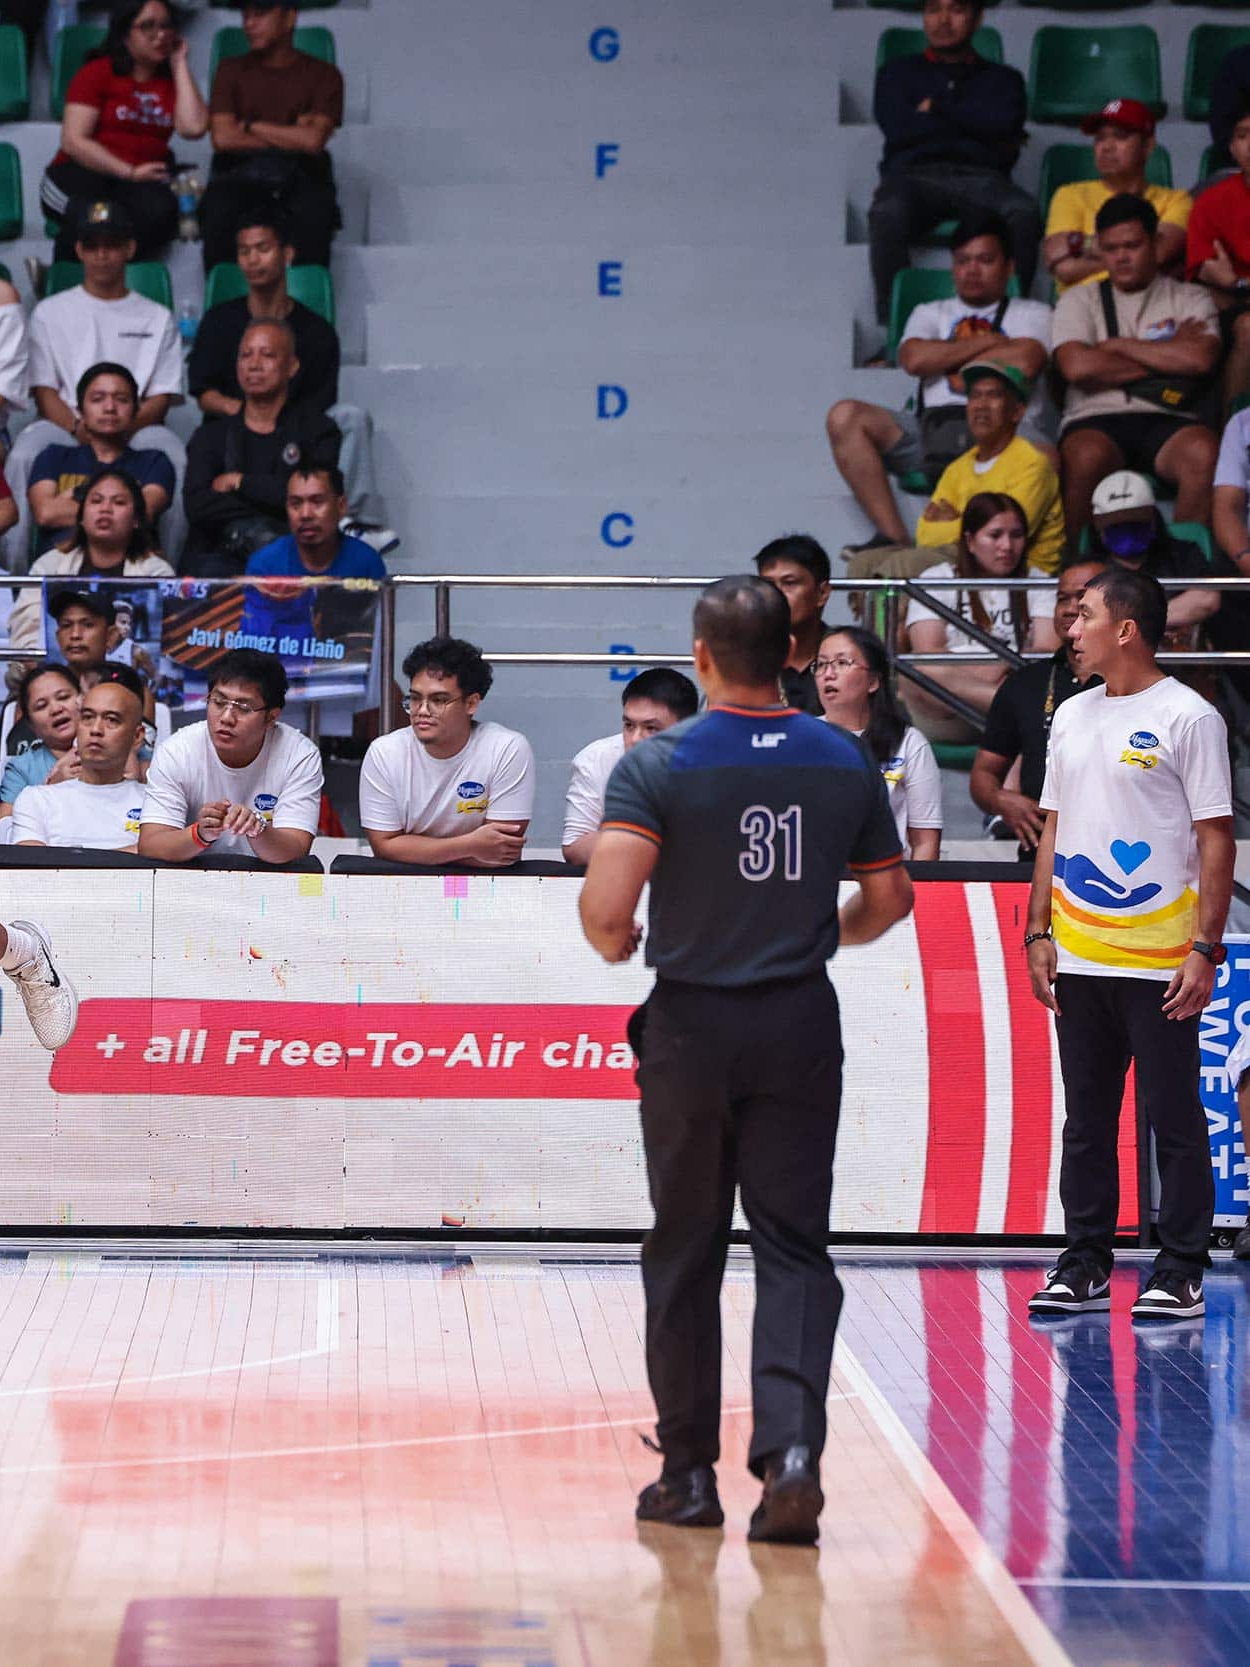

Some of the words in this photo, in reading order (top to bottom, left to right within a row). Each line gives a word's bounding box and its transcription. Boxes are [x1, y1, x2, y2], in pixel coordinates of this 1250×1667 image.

[589, 27, 620, 63] G
[596, 143, 620, 178] F
[598, 262, 622, 296] E
[598, 384, 629, 419] D
[601, 512, 634, 548] C
[187, 627, 221, 647] Javi
[279, 636, 299, 655] de
[739, 804, 802, 882] 31
[142, 1028, 209, 1065] all
[225, 1030, 526, 1068] Free-To-Air
[541, 1033, 640, 1069] cha
